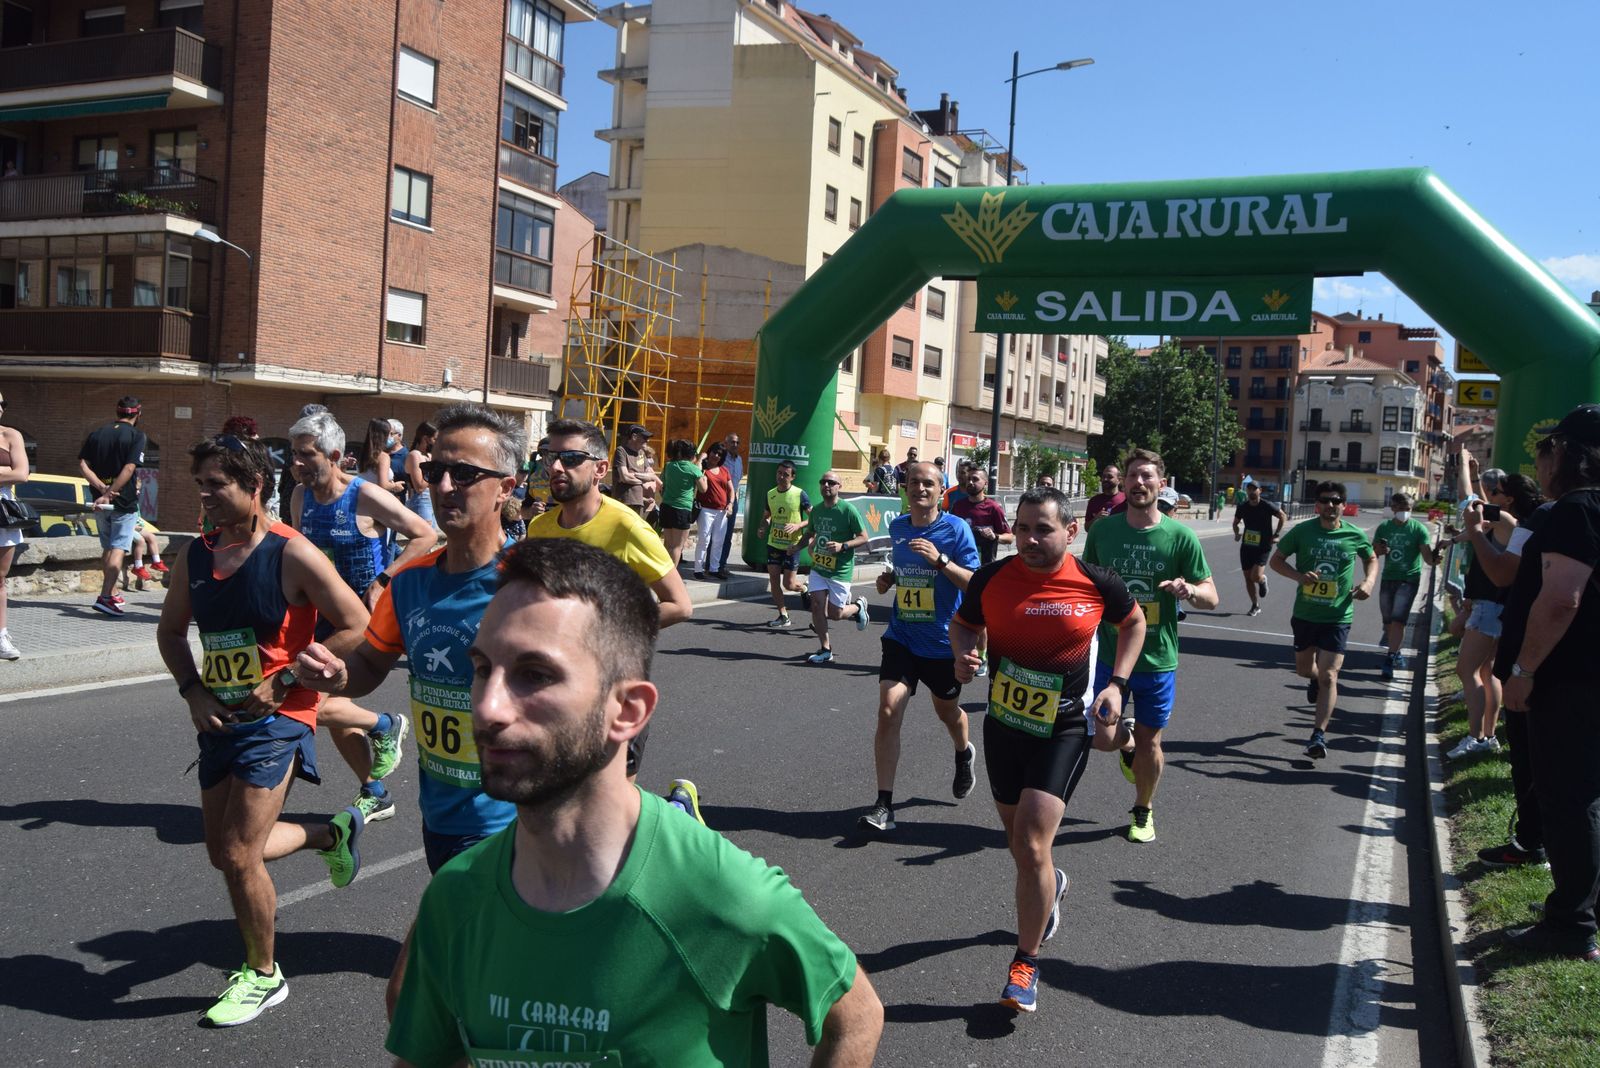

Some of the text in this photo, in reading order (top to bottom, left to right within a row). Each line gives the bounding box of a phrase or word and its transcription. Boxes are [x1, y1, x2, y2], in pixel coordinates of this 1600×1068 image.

[1041, 192, 1348, 243] CAJA RURAL
[1034, 290, 1241, 323] SALIDA
[1002, 313, 1026, 321] RURAL
[1270, 312, 1298, 321] RURAL
[763, 443, 810, 458] RURAL
[773, 528, 789, 540] 204
[815, 554, 832, 568] 212
[1311, 582, 1328, 595] 79
[903, 590, 921, 607] 41
[1025, 607, 1072, 616] zamora
[1040, 602, 1072, 610] triatlón
[460, 634, 471, 647] DE
[205, 651, 254, 683] 202
[1015, 668, 1054, 683] FUNDACION
[1030, 678, 1053, 689] RURAL
[443, 699, 472, 710] RURAL
[1001, 680, 1048, 718] 192
[421, 710, 461, 755] 96
[1023, 719, 1049, 734] RURAL
[446, 766, 480, 780] RURAL
[489, 993, 510, 1019] VII
[521, 1000, 610, 1033] CARRERA
